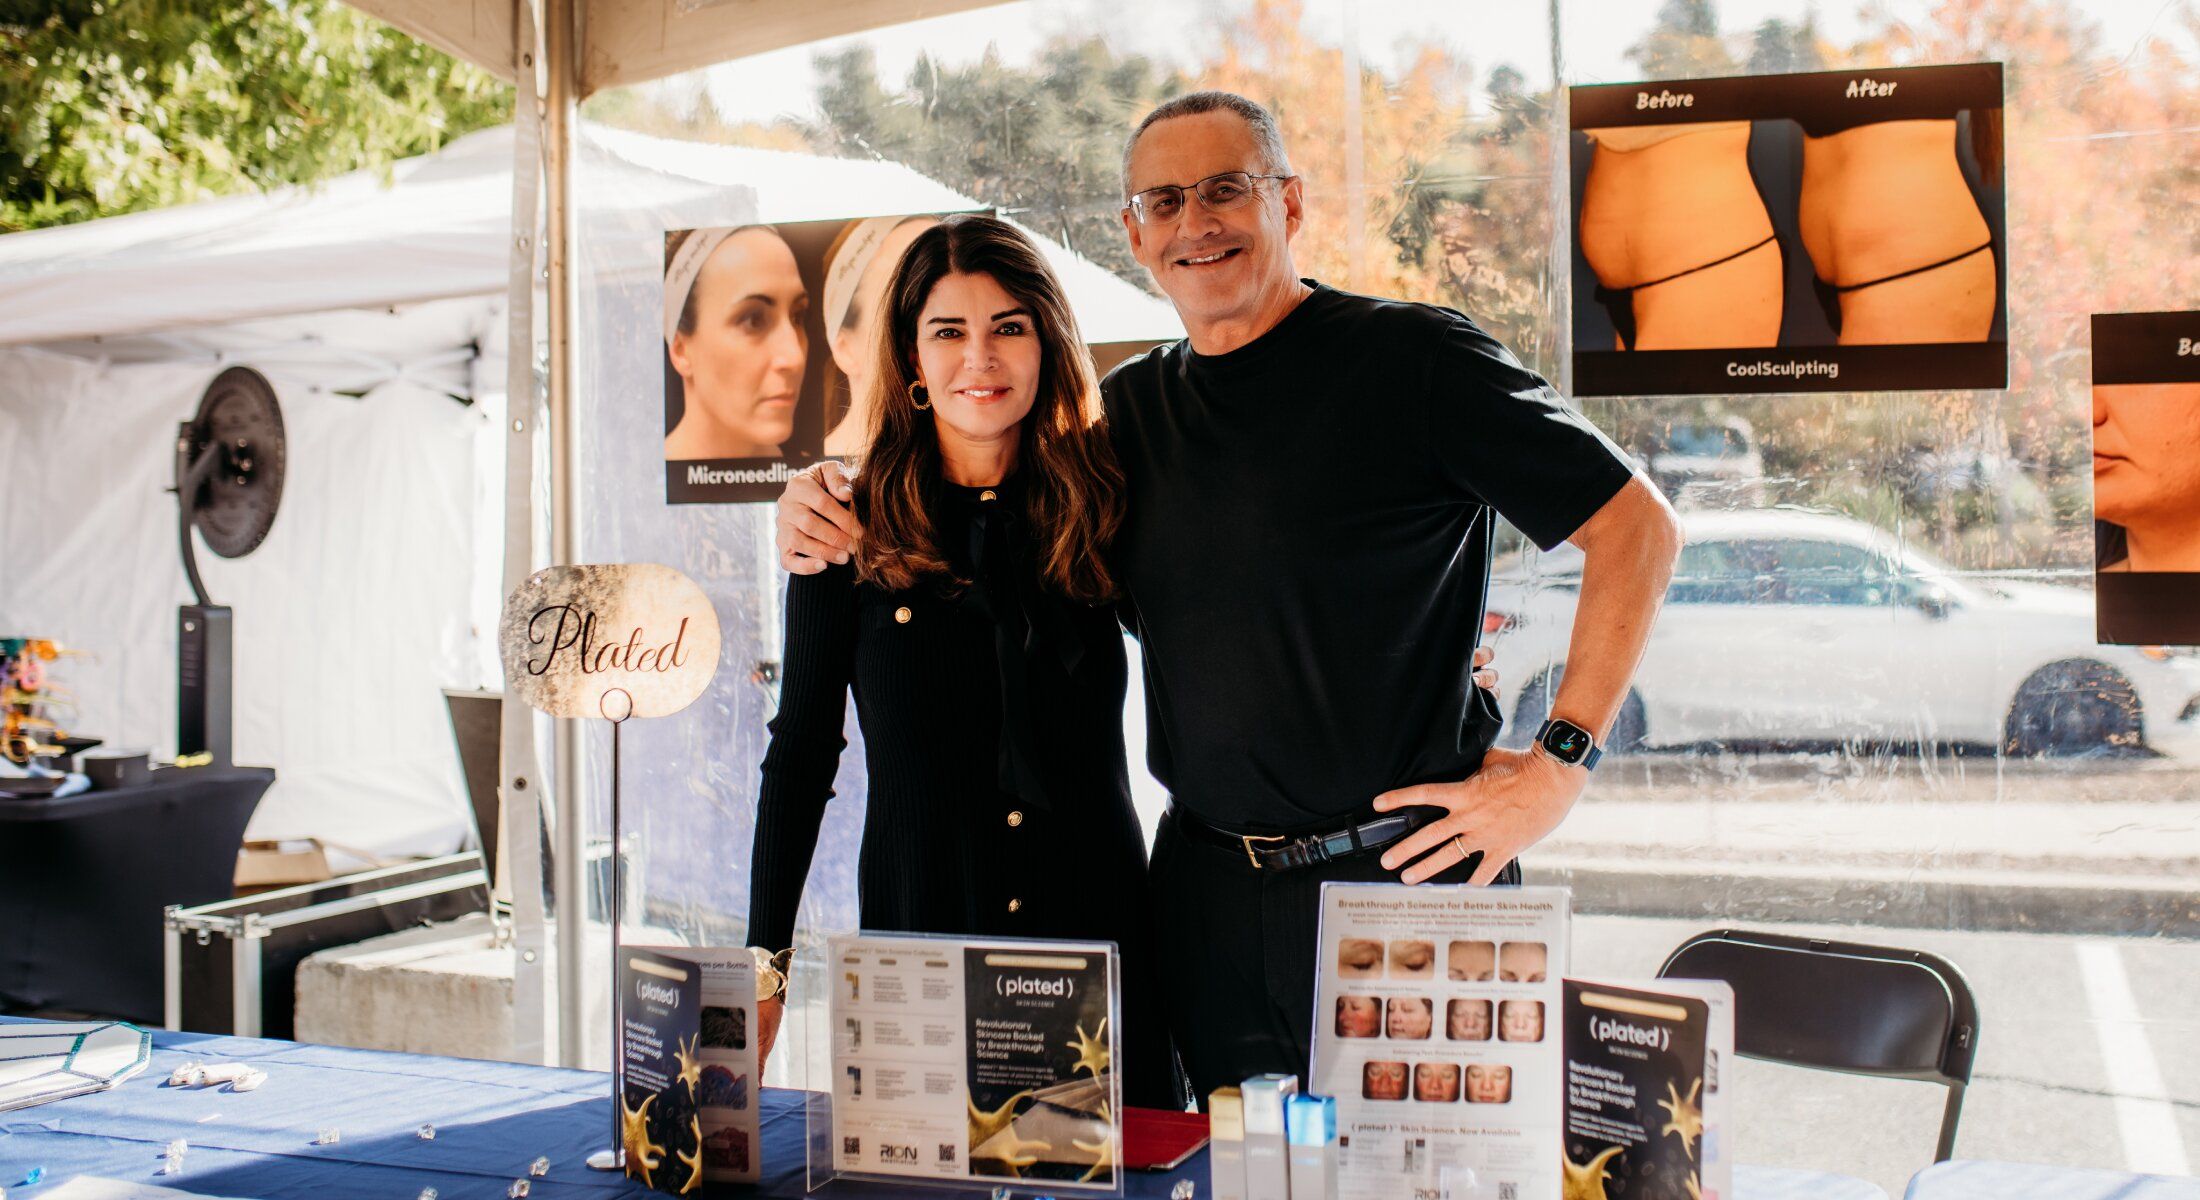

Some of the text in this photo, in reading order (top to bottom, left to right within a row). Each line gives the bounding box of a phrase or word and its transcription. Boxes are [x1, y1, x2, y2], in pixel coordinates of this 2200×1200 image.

[1846, 78, 1897, 99] After
[1636, 91, 1694, 110] Before
[1726, 360, 1839, 379] CoolSculpting
[687, 462, 806, 485] Microneedlin
[527, 603, 689, 676] Plated
[1338, 900, 1554, 912] Breakthrough Science for Better Skin Health
[976, 1018, 1032, 1032] Revolutionary
[976, 1029, 1044, 1042] Skincare Backed
[976, 1040, 1044, 1054] by Breakthrough
[976, 1049, 1009, 1060] Science
[1400, 1125, 1419, 1134] Skin
[1460, 1127, 1478, 1136] Now
[1481, 1127, 1521, 1137] Available
[880, 1144, 917, 1160] RION
